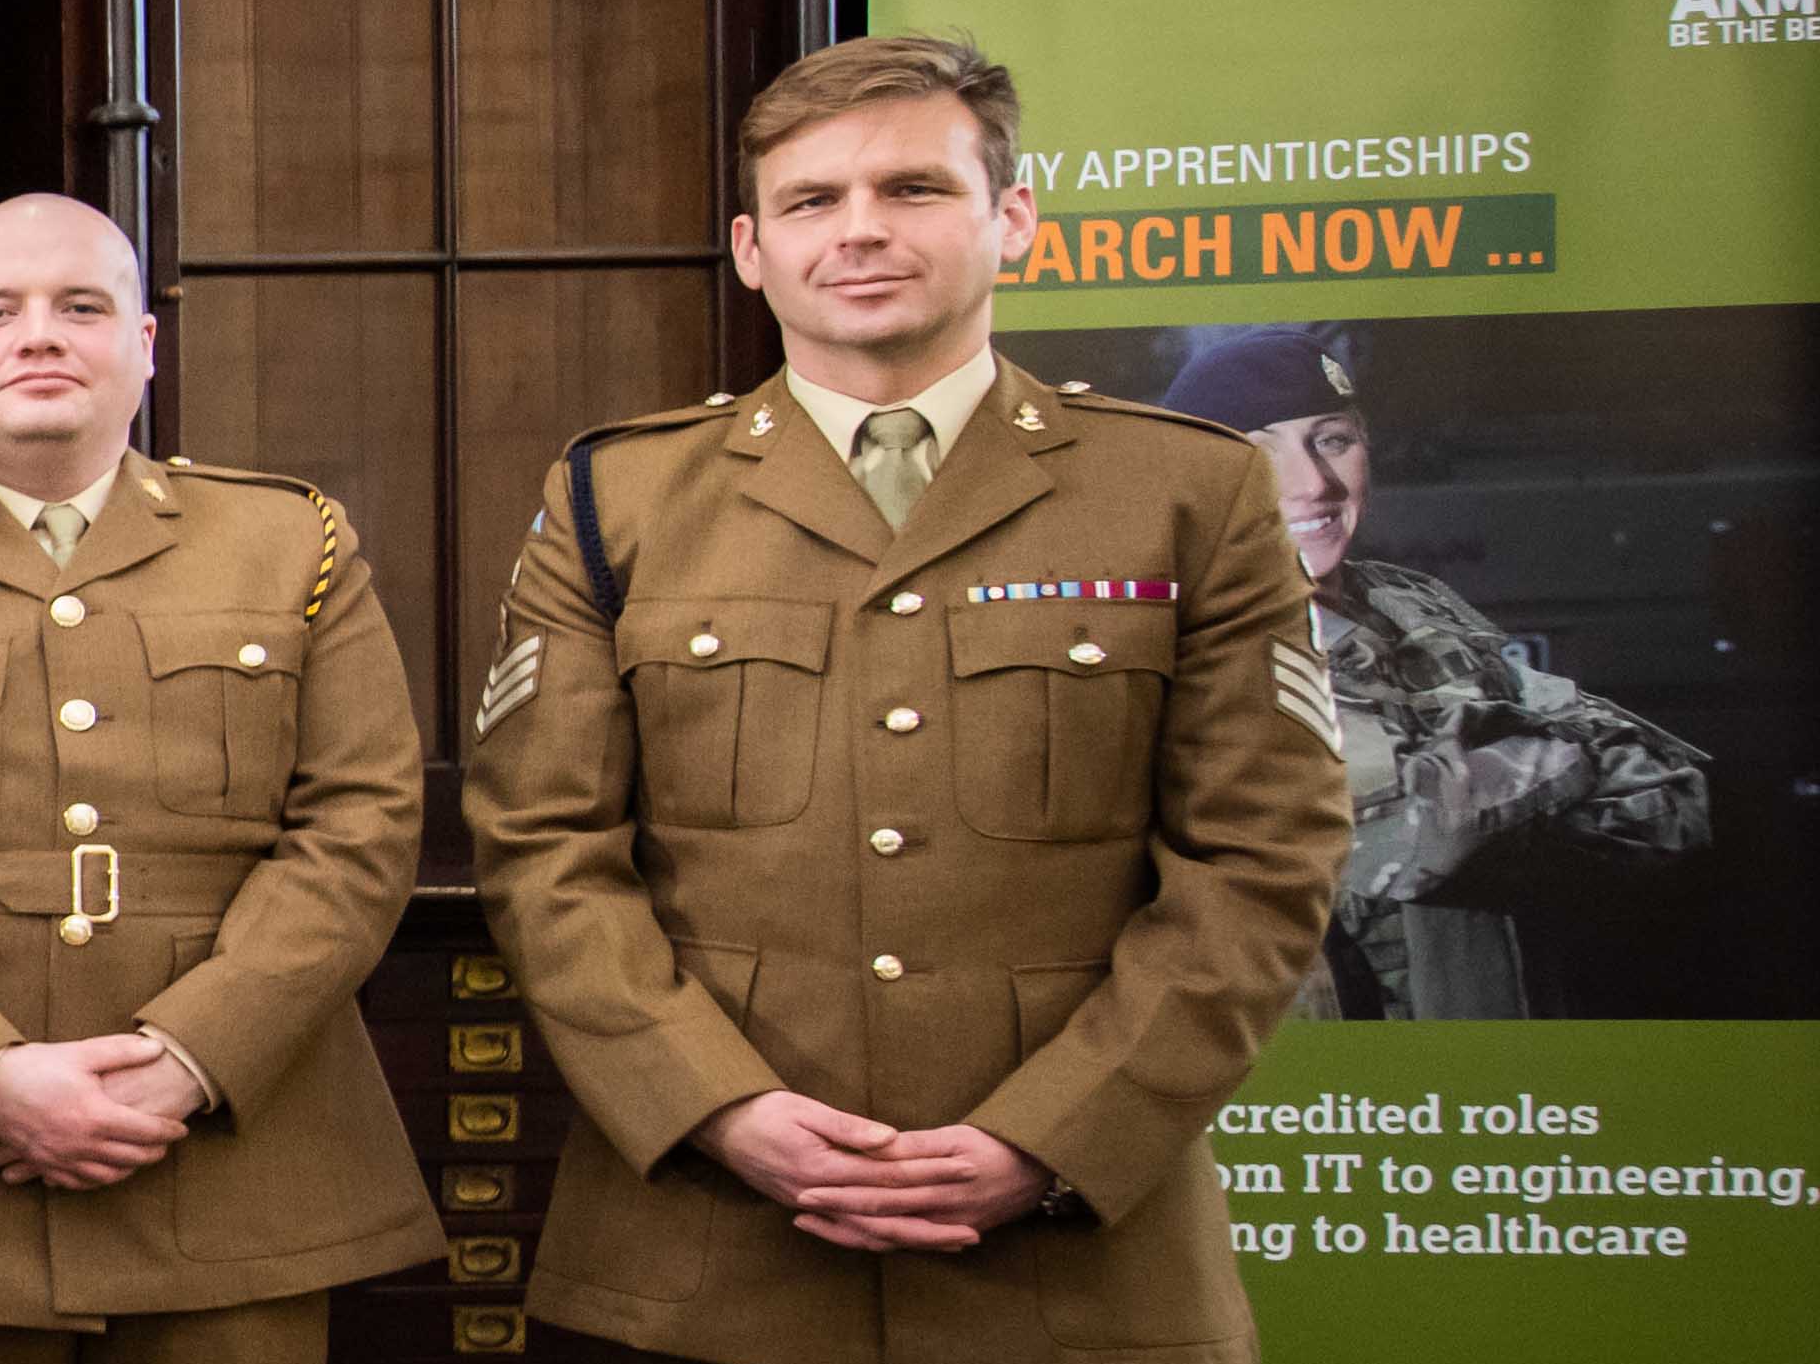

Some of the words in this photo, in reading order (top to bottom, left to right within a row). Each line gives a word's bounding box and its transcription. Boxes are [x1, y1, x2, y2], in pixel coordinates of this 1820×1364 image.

[1669, 22, 1710, 47] BE
[1715, 19, 1777, 43] THE
[1785, 16, 1820, 41] BE
[1077, 132, 1531, 190] APPRENTICESHIPS
[997, 215, 1232, 284] ARCH
[1261, 206, 1463, 275] NOW
[1206, 1093, 1443, 1135] credited
[1460, 1093, 1600, 1136] roles
[1303, 1154, 1362, 1194] IT
[1379, 1156, 1434, 1195] to
[1451, 1154, 1820, 1206] engineering,
[1312, 1216, 1367, 1254] to
[1383, 1212, 1688, 1256] healthcare
